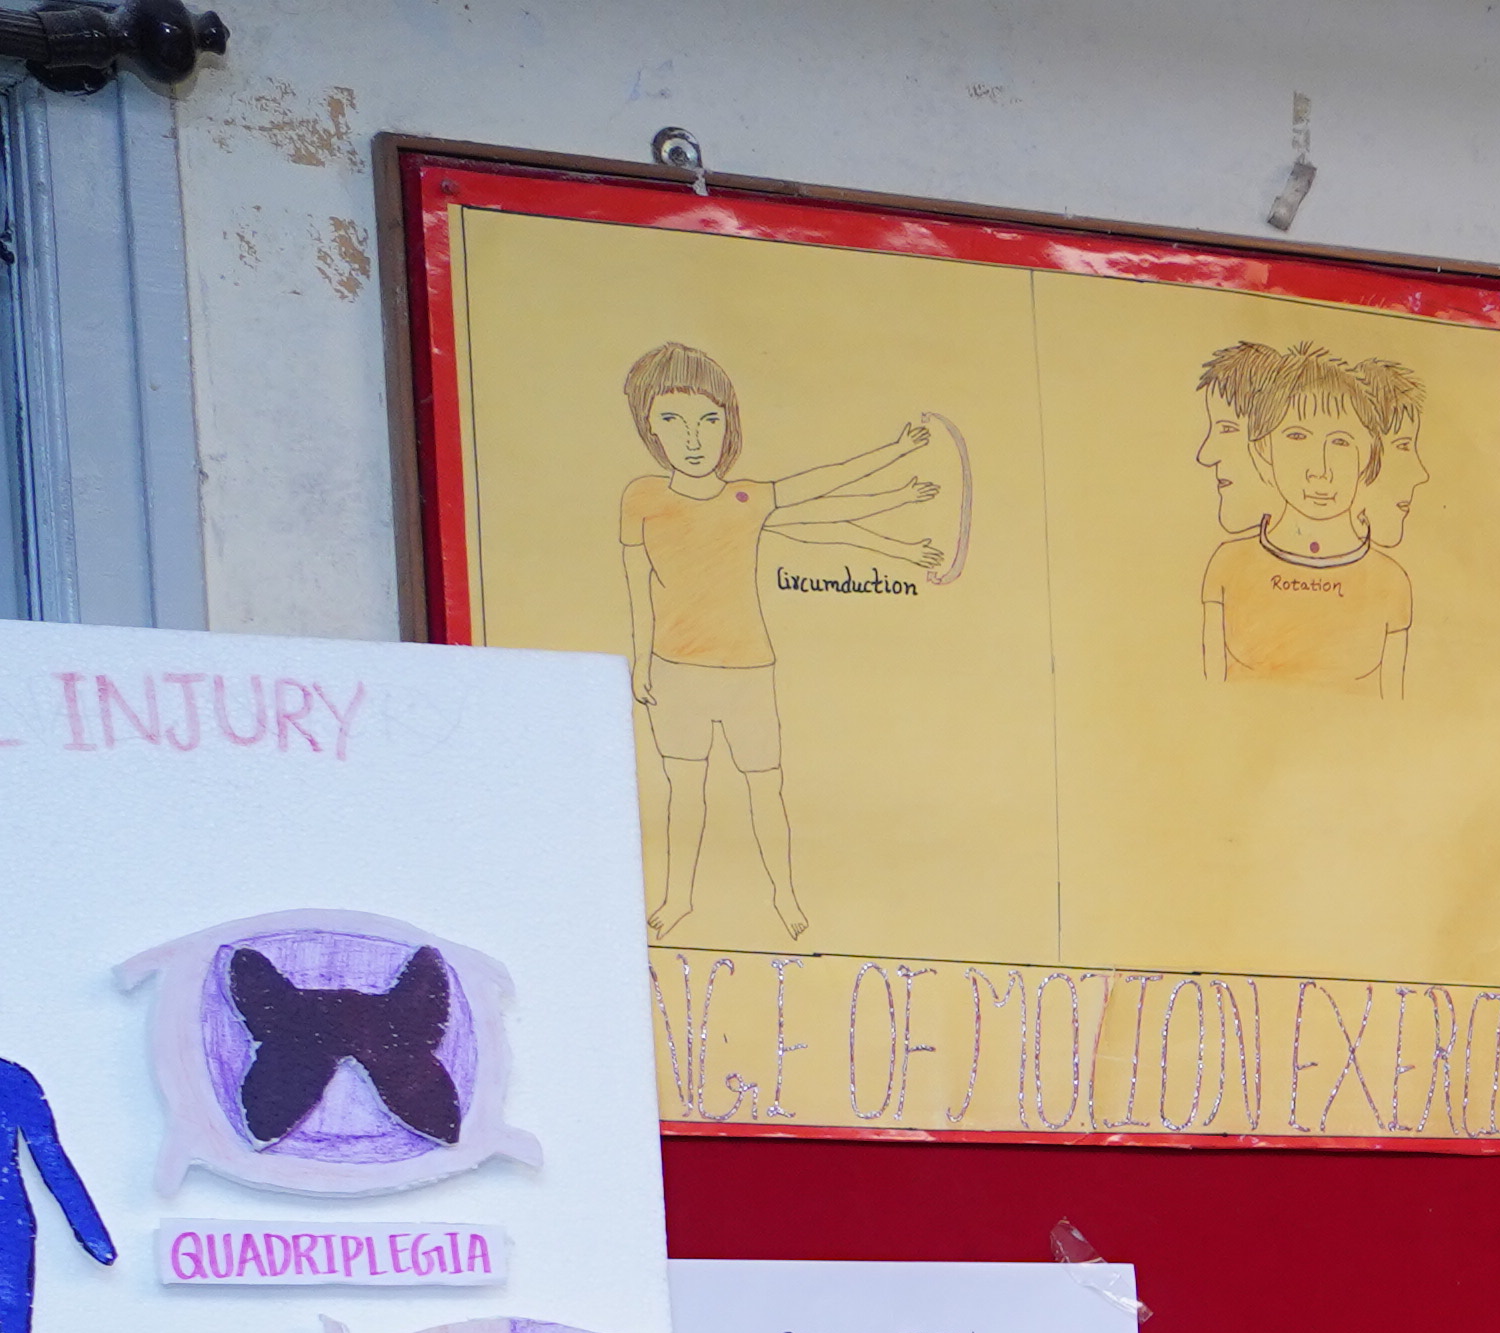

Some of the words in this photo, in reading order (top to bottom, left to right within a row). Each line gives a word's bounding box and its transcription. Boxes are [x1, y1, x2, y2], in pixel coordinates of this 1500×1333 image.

[1270, 575, 1345, 598] Rotation
[55, 672, 367, 761] INJURY
[648, 952, 807, 1121] NGE
[848, 960, 938, 1121] OF
[946, 966, 1263, 1132] MOTION
[170, 1231, 492, 1281] QUADRIPLEGIA
